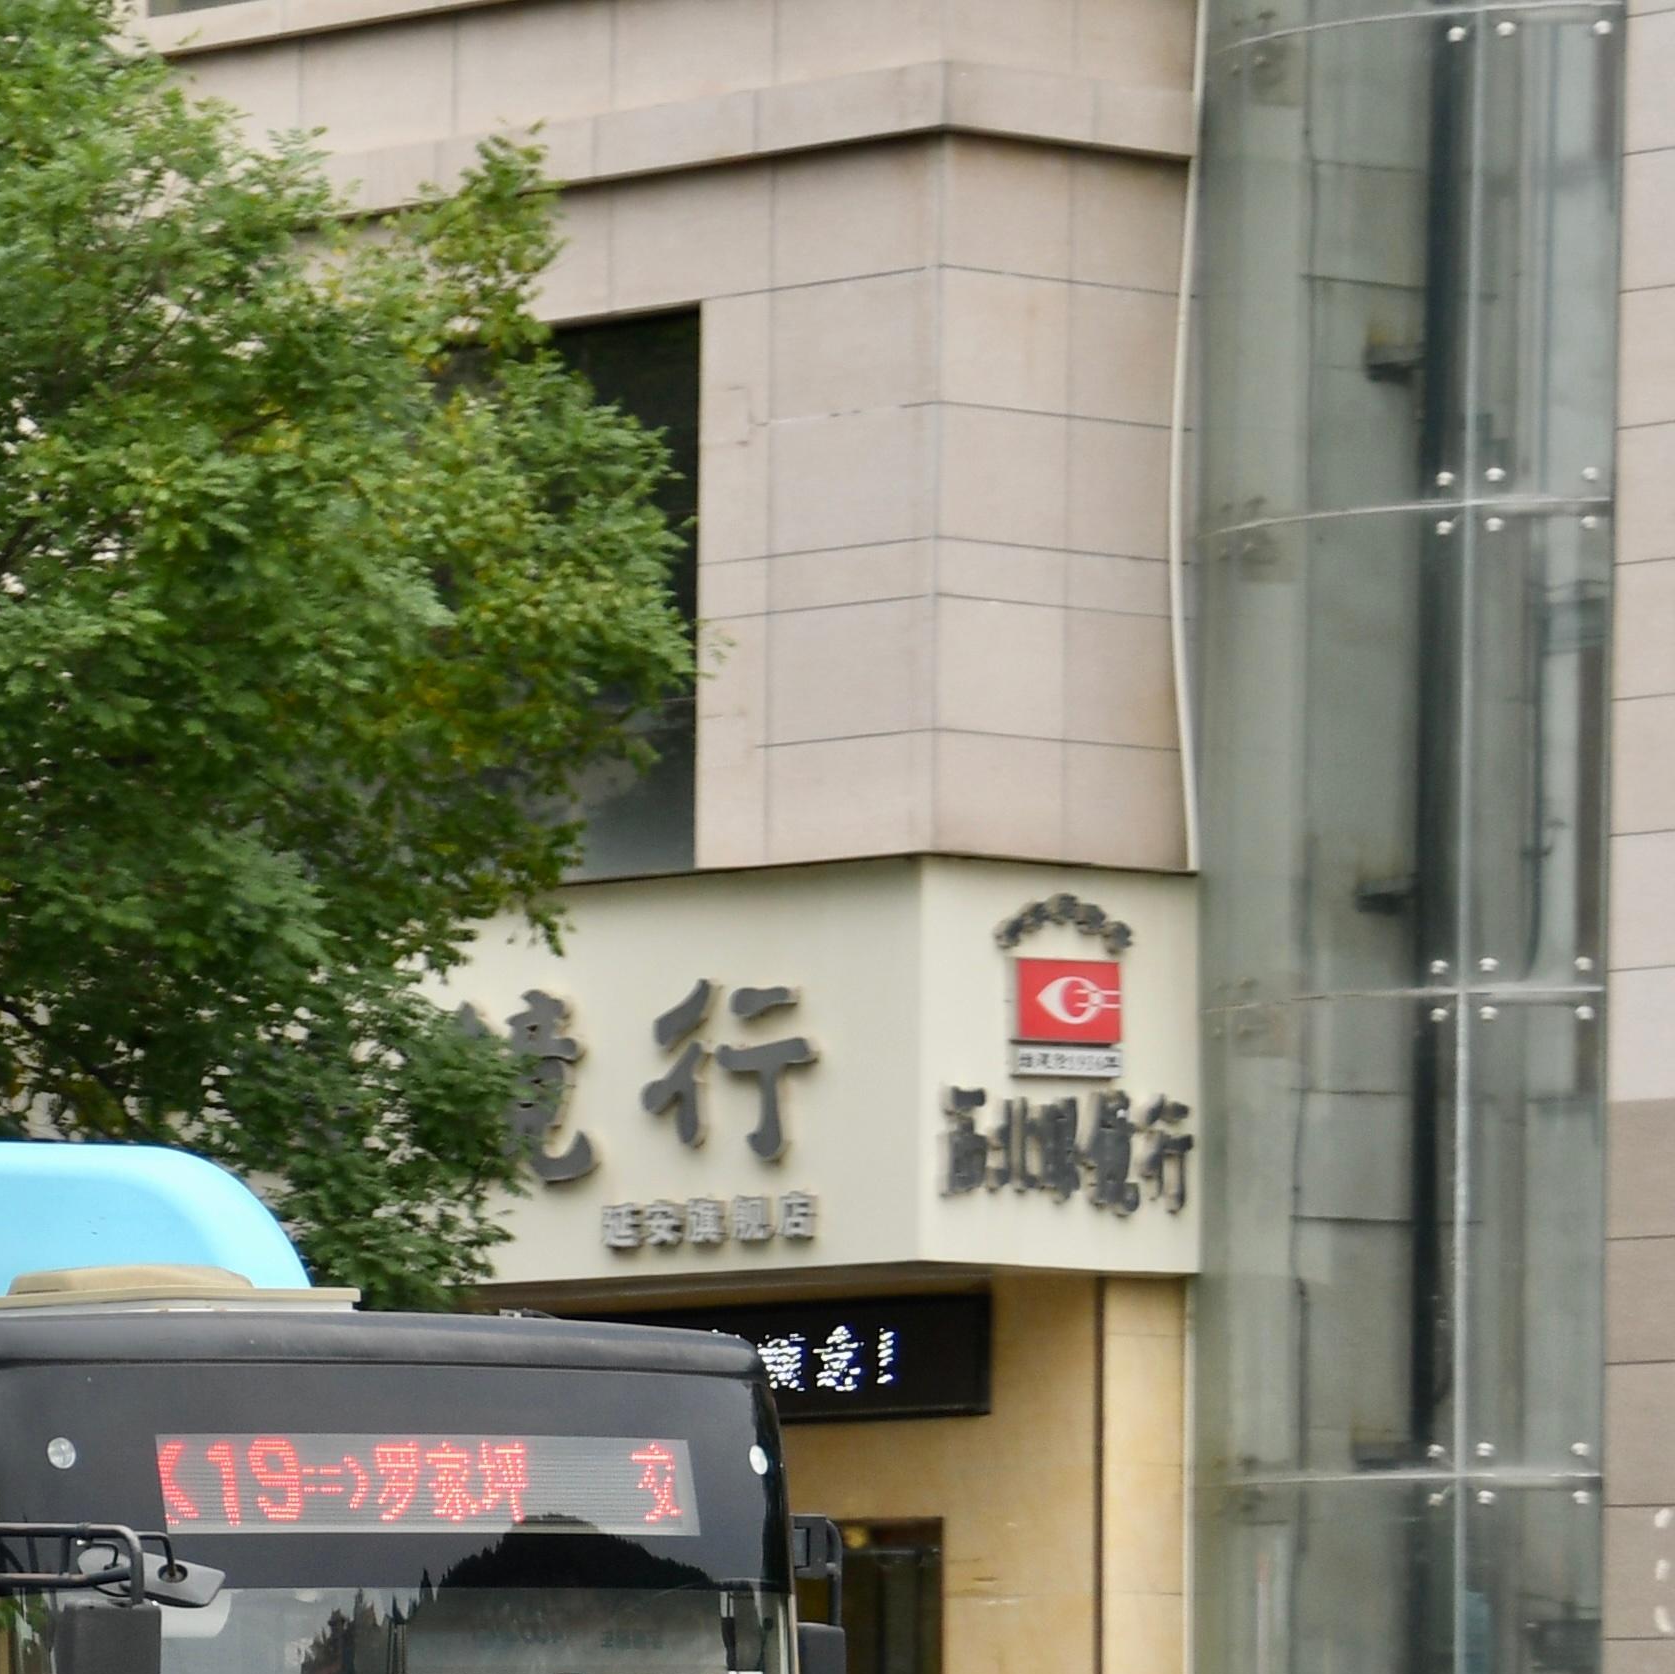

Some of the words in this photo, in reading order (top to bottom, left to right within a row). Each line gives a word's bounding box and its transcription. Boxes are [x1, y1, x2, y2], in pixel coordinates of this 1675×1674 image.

[601, 1191, 817, 1249] 延安旗舰店
[374, 1440, 526, 1523] 罗家坪
[630, 1441, 682, 1523] 交
